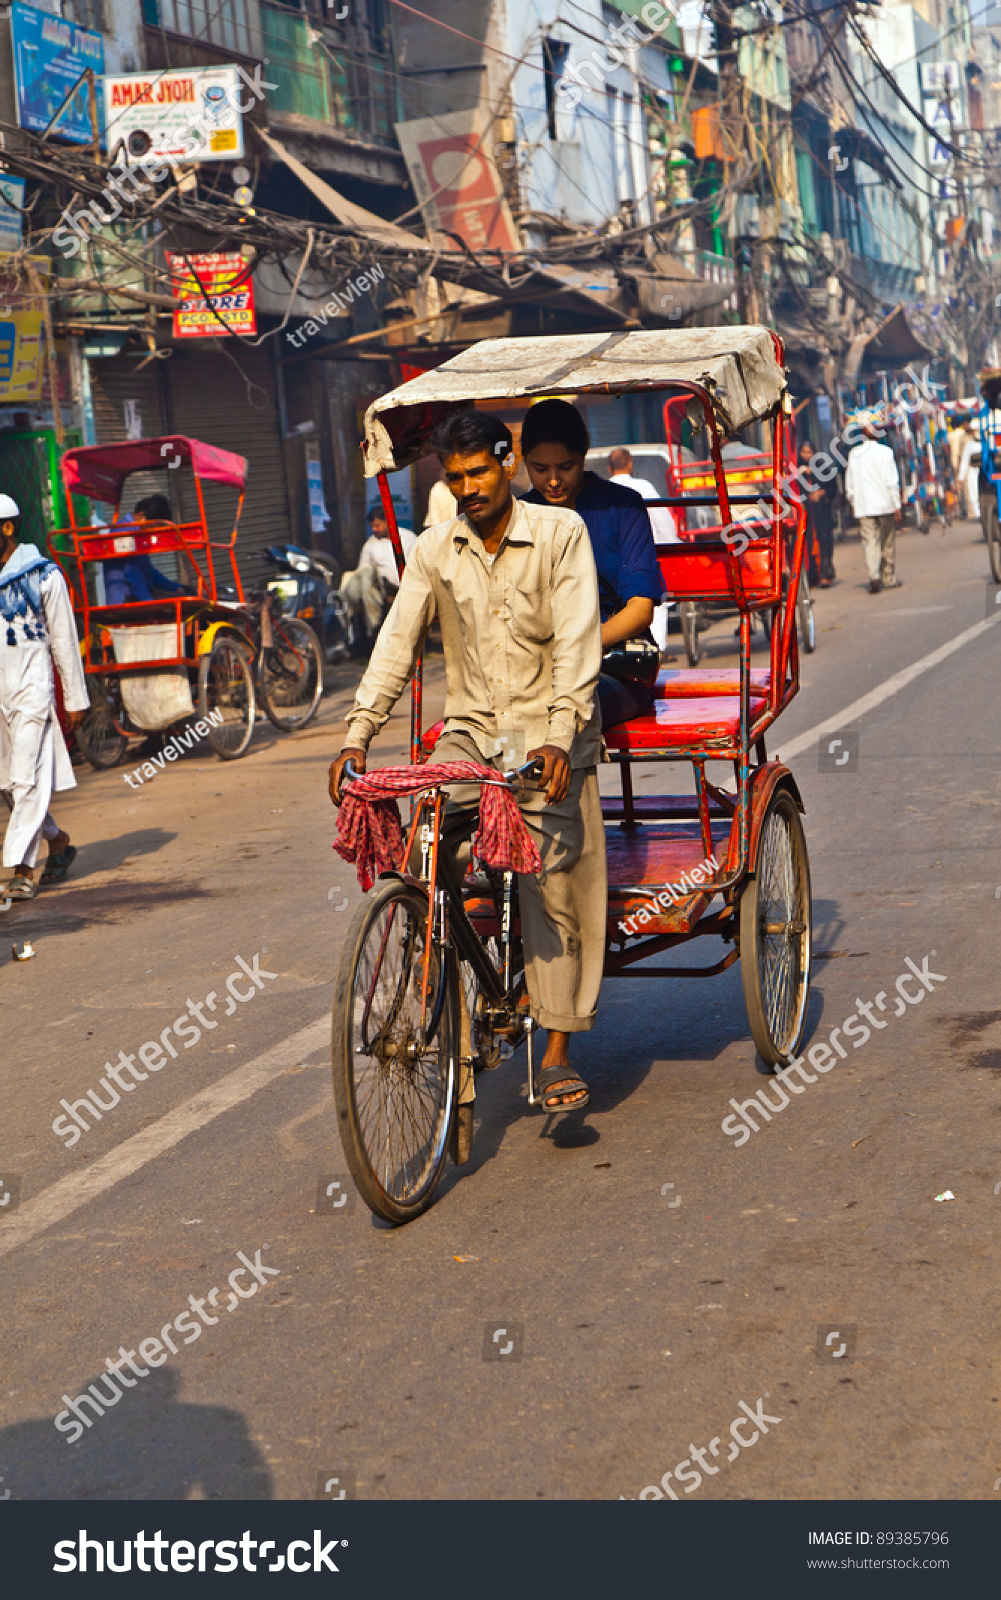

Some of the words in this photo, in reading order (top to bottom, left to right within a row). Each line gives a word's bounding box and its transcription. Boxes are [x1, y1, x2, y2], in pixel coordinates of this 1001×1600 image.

[110, 81, 154, 107] AMAR
[156, 77, 196, 103] JYOTI
[182, 292, 250, 311] STORE
